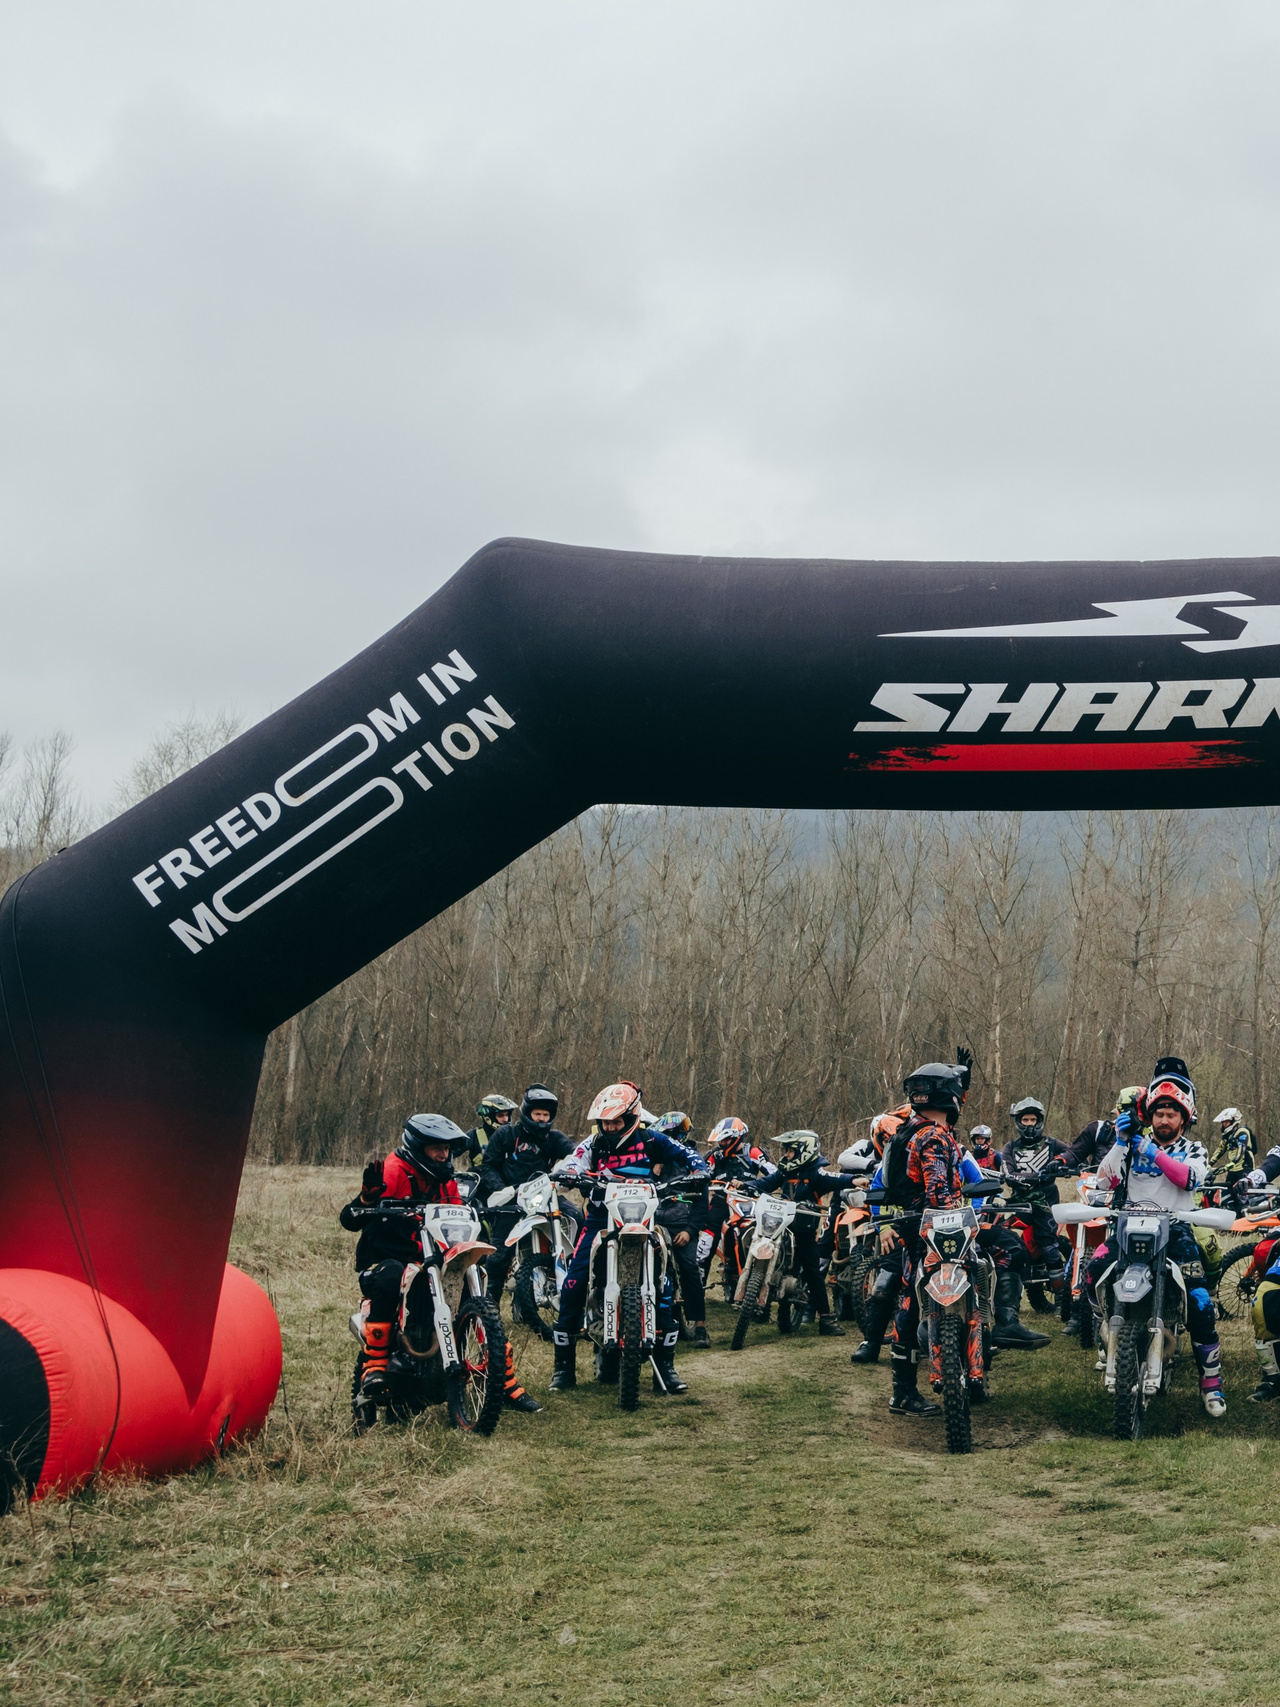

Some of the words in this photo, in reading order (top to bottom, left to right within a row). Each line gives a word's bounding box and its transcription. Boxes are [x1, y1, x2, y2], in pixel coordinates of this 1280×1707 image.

[132, 692, 422, 908] FREEDOM
[417, 649, 478, 706] IN
[168, 695, 516, 955] MOTION
[445, 1209, 464, 1217] 184
[940, 1216, 955, 1225] 111
[1139, 1219, 1146, 1227] 1
